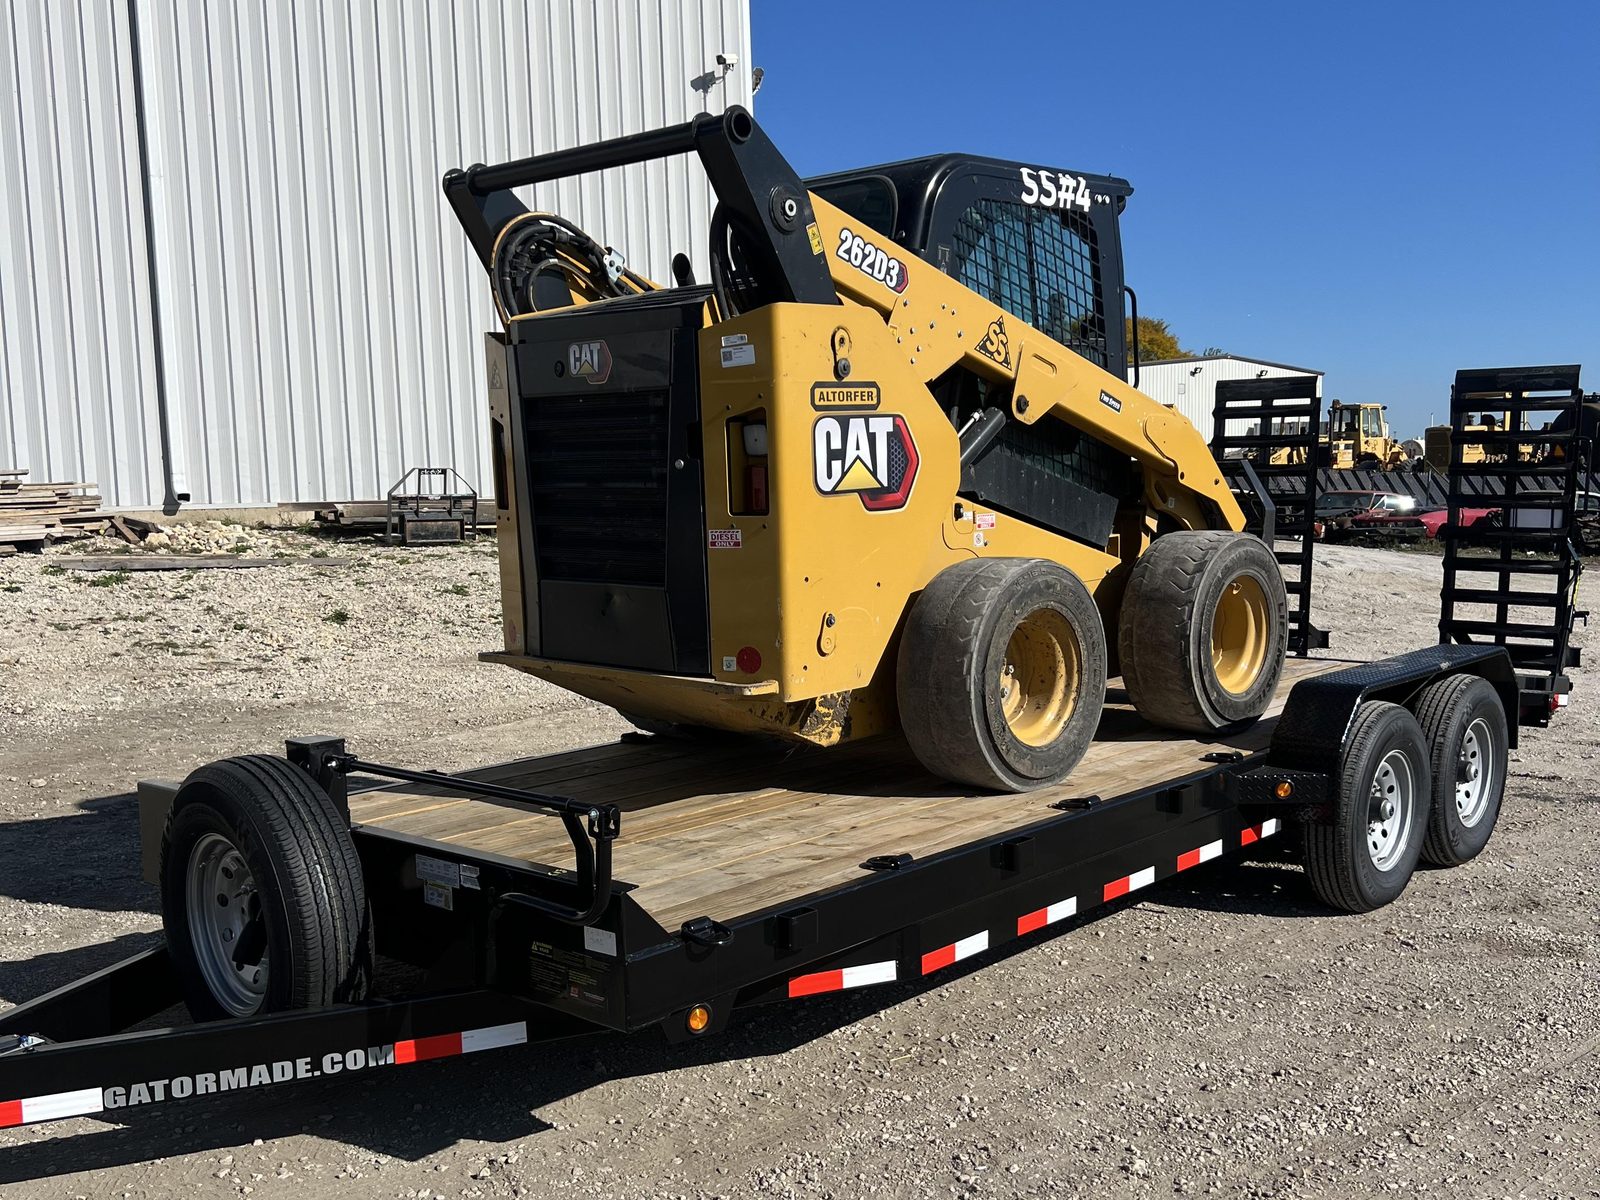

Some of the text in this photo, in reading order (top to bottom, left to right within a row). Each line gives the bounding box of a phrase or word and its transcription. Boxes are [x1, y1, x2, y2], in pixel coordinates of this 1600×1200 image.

[837, 229, 900, 288] 262D3
[569, 342, 601, 375] CAT
[986, 321, 1008, 363] SS
[818, 390, 875, 402] ALTORFER
[814, 416, 894, 492] CAT
[711, 533, 740, 541] DIESEL
[103, 1044, 395, 1109] GATORMADE.COM
